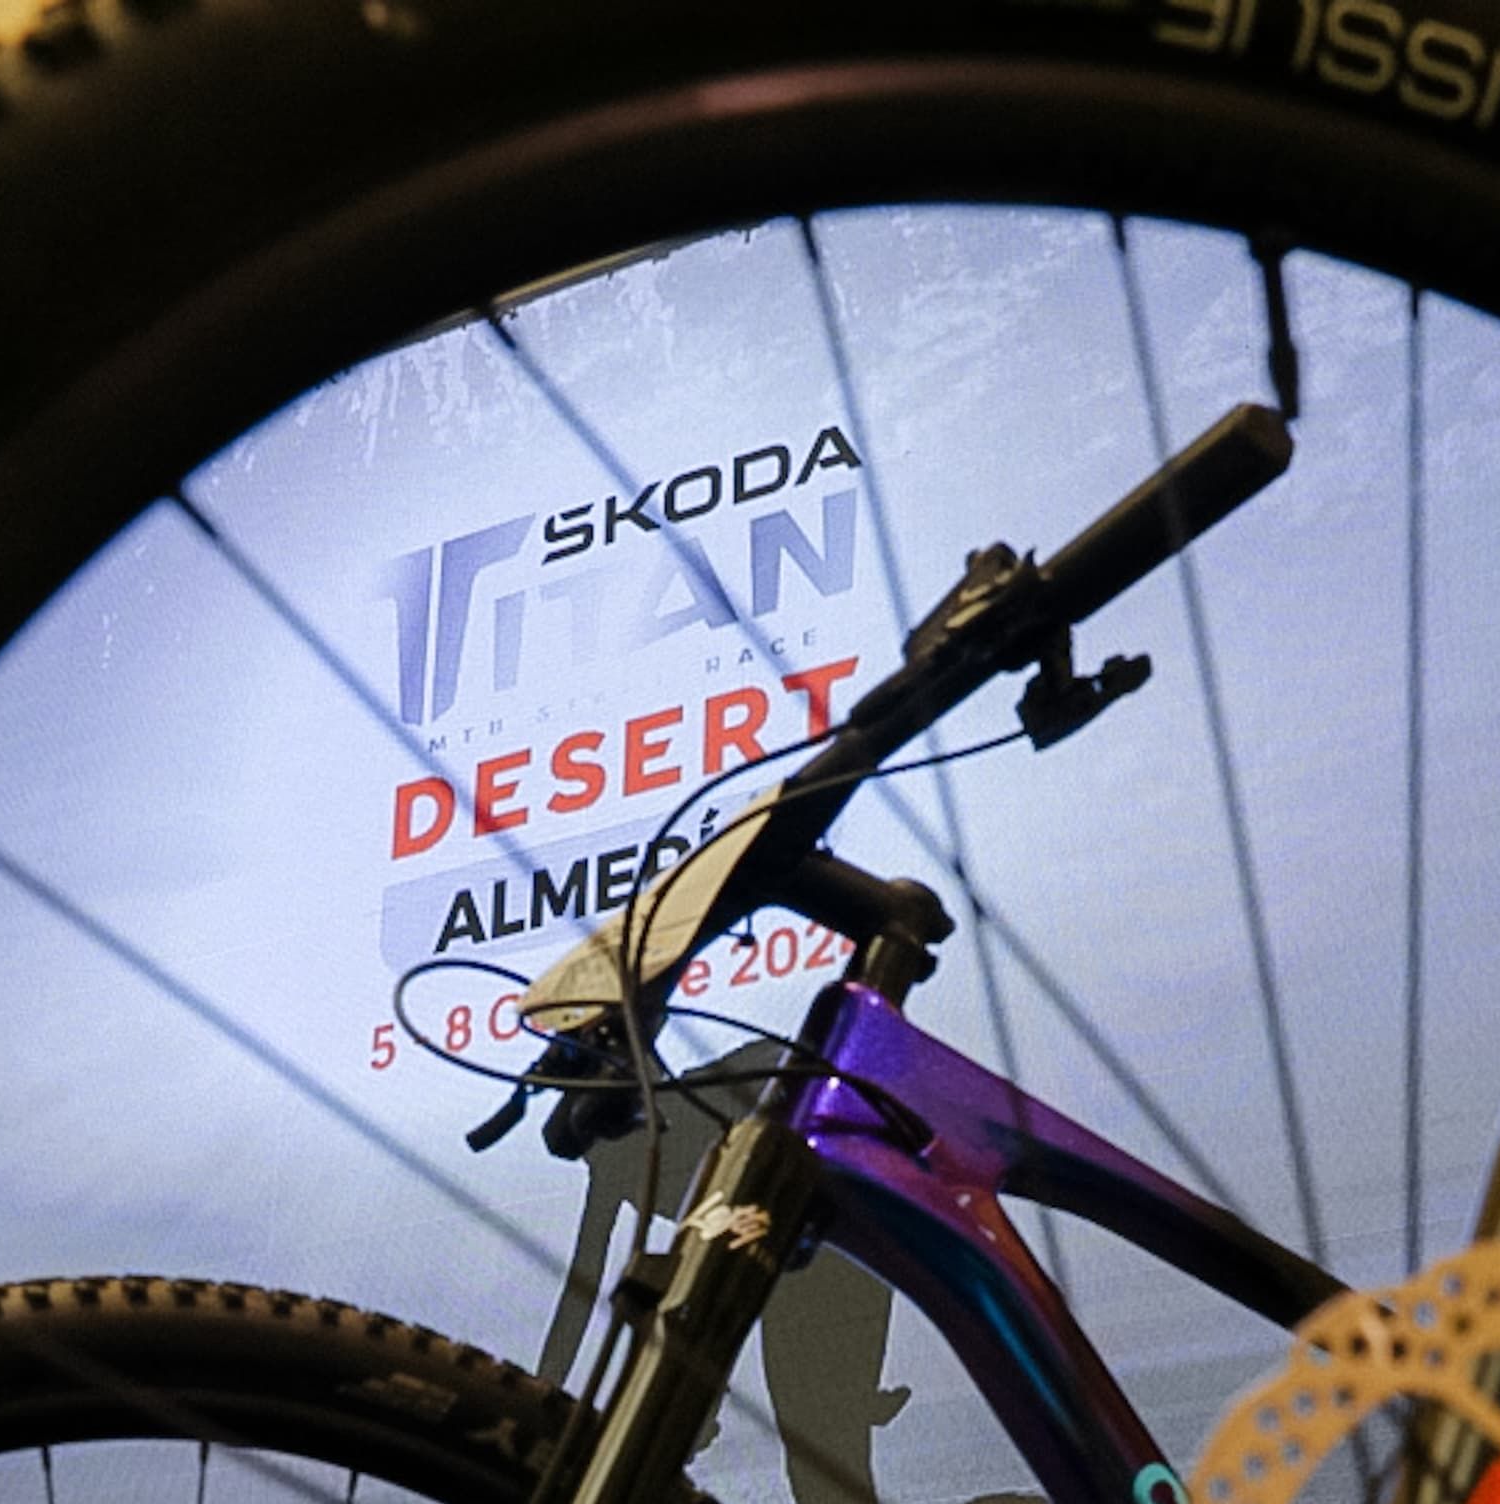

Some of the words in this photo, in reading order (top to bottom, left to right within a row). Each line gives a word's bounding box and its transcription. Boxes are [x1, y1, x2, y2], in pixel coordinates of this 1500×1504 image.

[392, 656, 859, 859] DESERT
[433, 807, 720, 955] ALMER
[371, 1024, 396, 1070] 5
[445, 1005, 472, 1053] 8
[729, 923, 857, 987] 202
